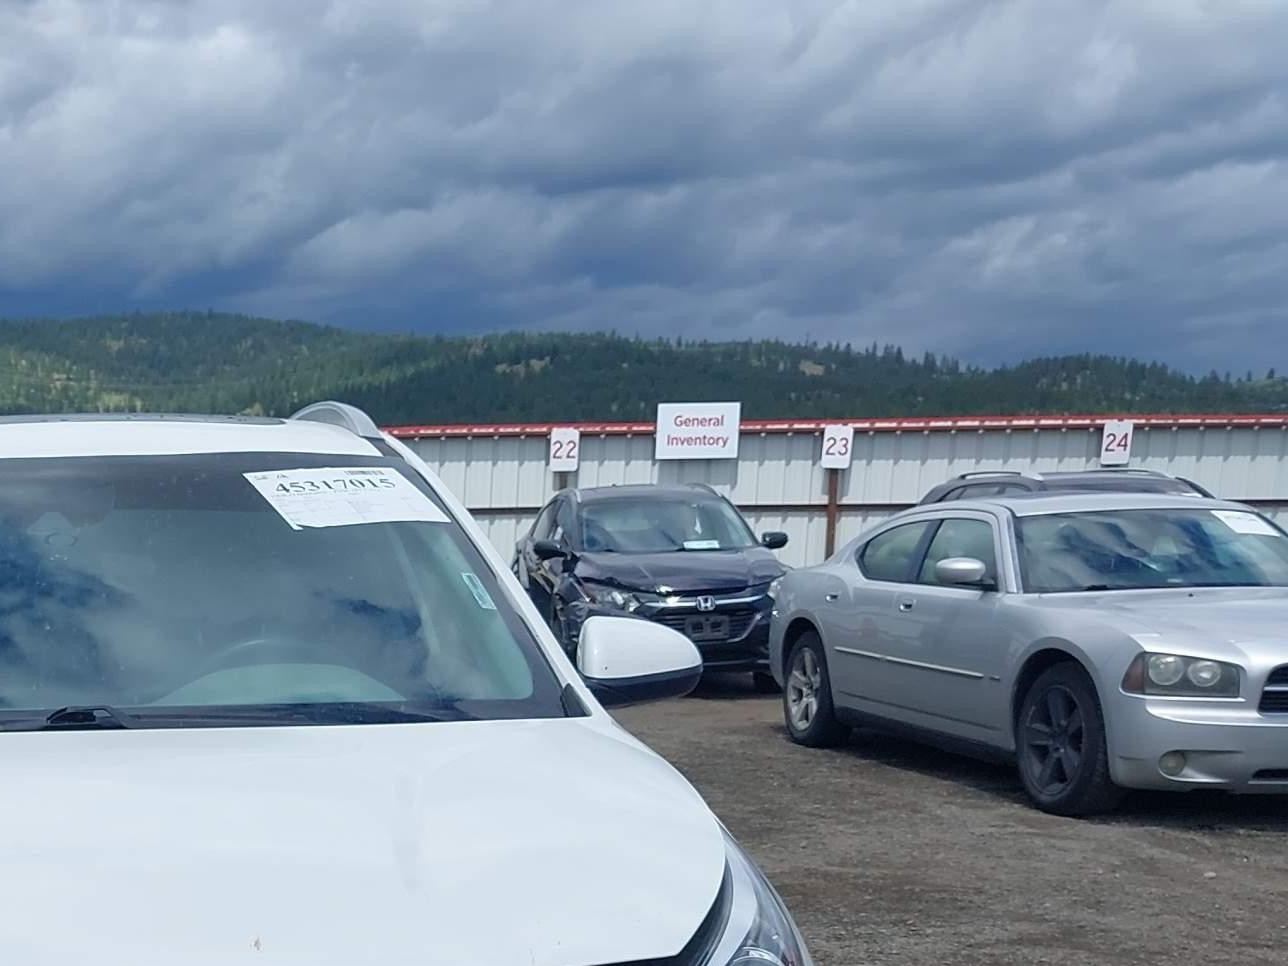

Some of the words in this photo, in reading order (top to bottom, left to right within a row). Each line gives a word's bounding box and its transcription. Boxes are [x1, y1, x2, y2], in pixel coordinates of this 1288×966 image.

[673, 414, 725, 428] General
[552, 440, 577, 459] 22
[666, 434, 730, 449] Inventory
[825, 436, 849, 456] 23
[1104, 432, 1129, 452] 24
[275, 478, 397, 494] 45317015
